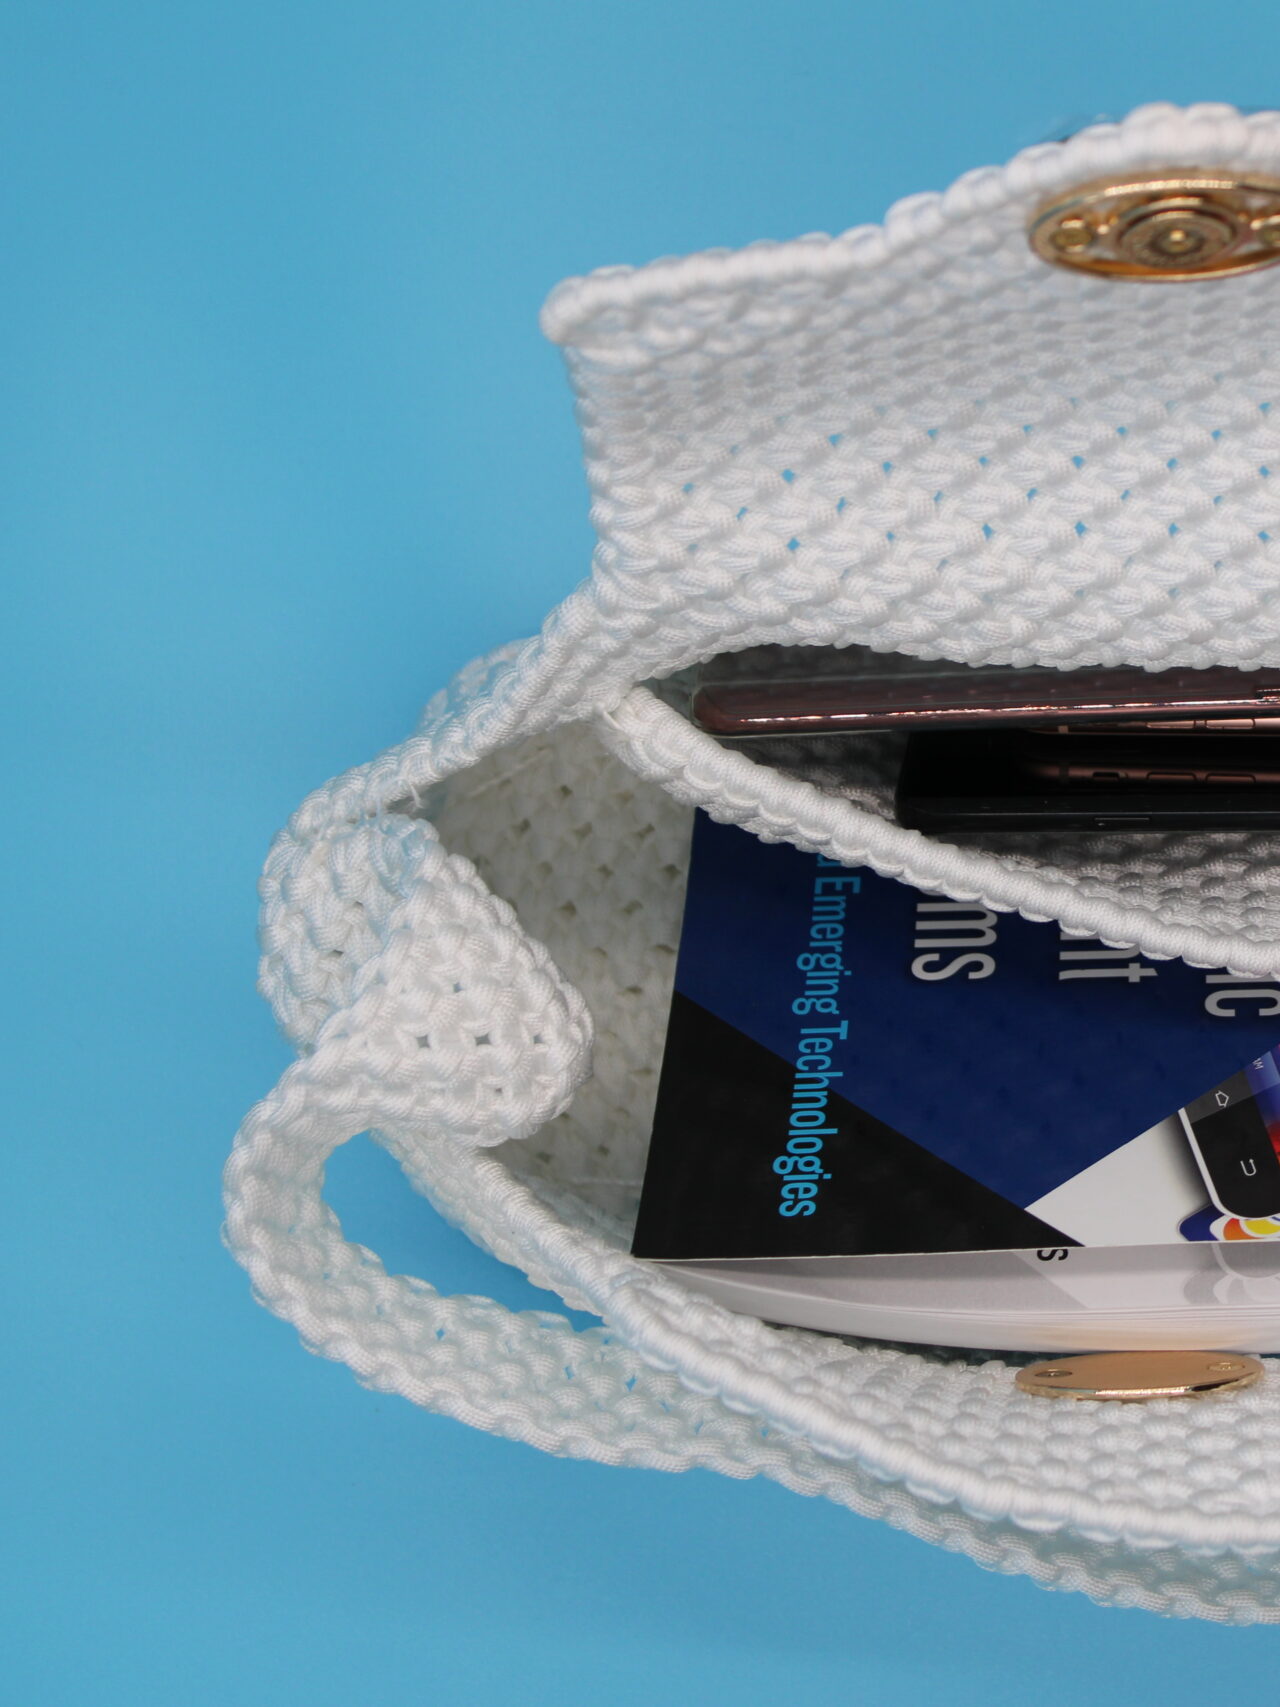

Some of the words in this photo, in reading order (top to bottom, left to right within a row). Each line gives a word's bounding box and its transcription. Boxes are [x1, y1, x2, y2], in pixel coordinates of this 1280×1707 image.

[792, 876, 861, 1016] Emerging
[911, 902, 998, 981] ms
[773, 1020, 849, 1217] Technologies
